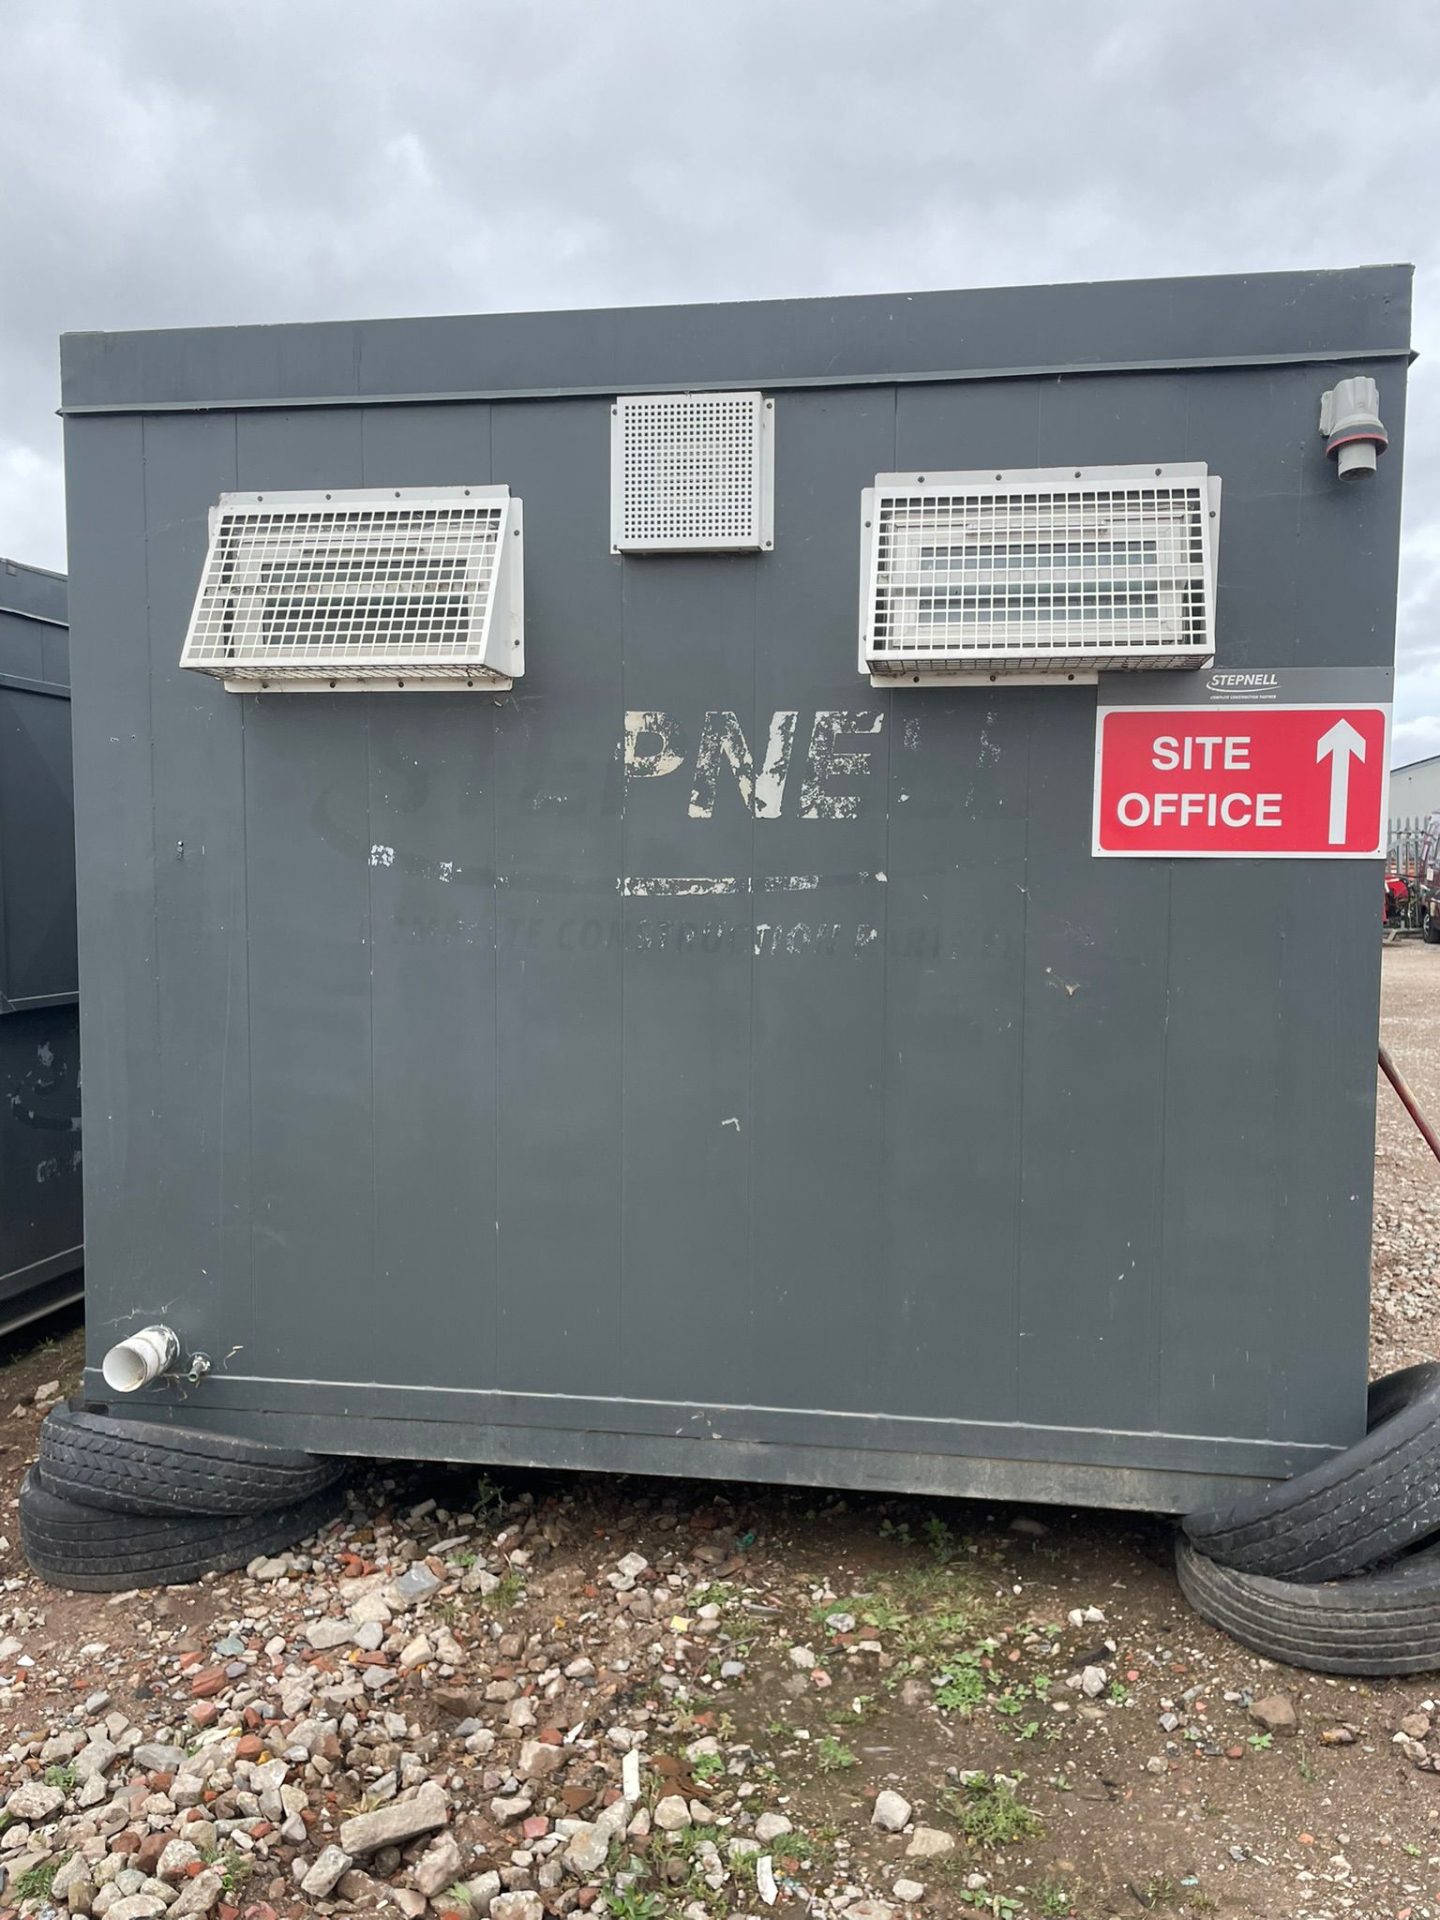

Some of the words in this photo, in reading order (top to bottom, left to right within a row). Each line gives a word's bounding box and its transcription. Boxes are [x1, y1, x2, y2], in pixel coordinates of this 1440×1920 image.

[1211, 674, 1278, 686] STEPNELL
[1151, 735, 1251, 771] SITE
[1117, 792, 1283, 827] OFFICE
